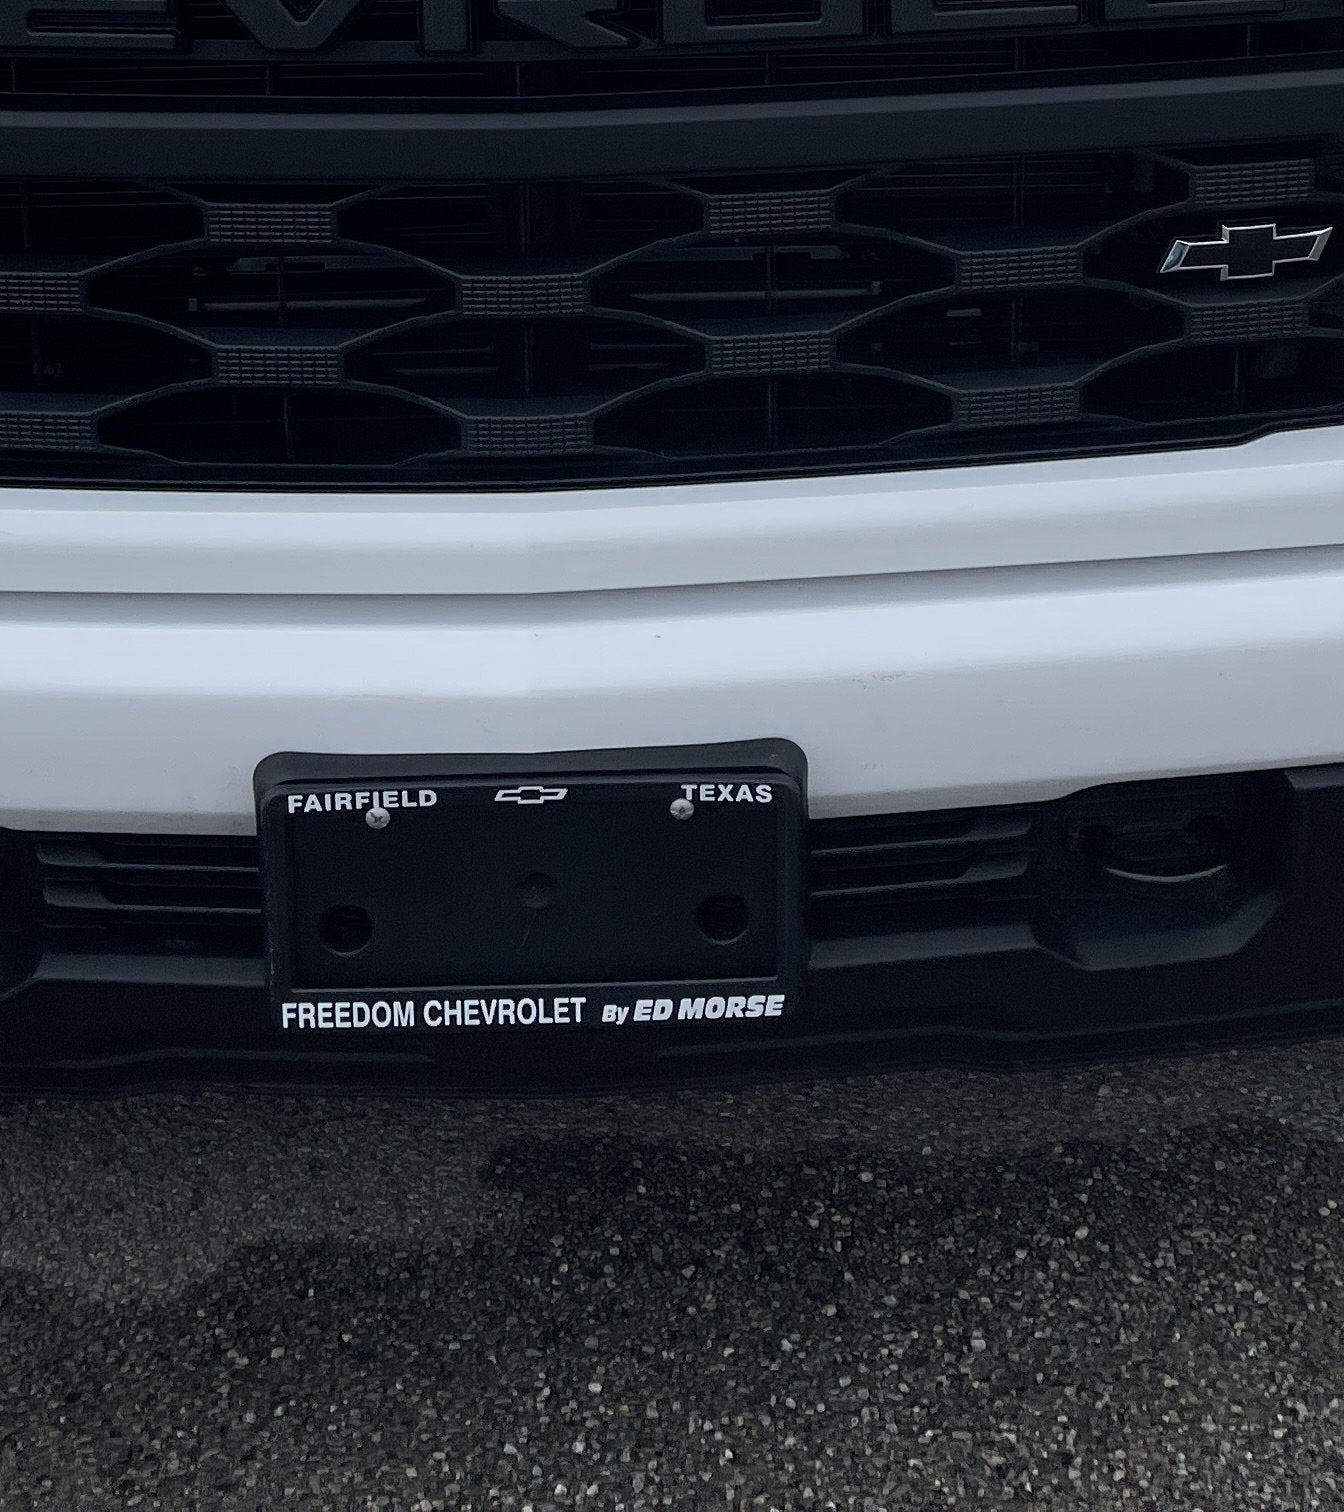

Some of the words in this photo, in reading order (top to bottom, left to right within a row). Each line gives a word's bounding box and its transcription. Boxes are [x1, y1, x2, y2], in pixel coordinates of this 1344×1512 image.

[287, 789, 438, 814] FAIRFIELD
[680, 784, 773, 804] TEXAS
[281, 1000, 415, 1029] FREEDOM
[423, 996, 587, 1027] CHEVROLET
[601, 1003, 630, 1025] By
[633, 999, 674, 1022] ED
[677, 994, 786, 1020] MORSE
